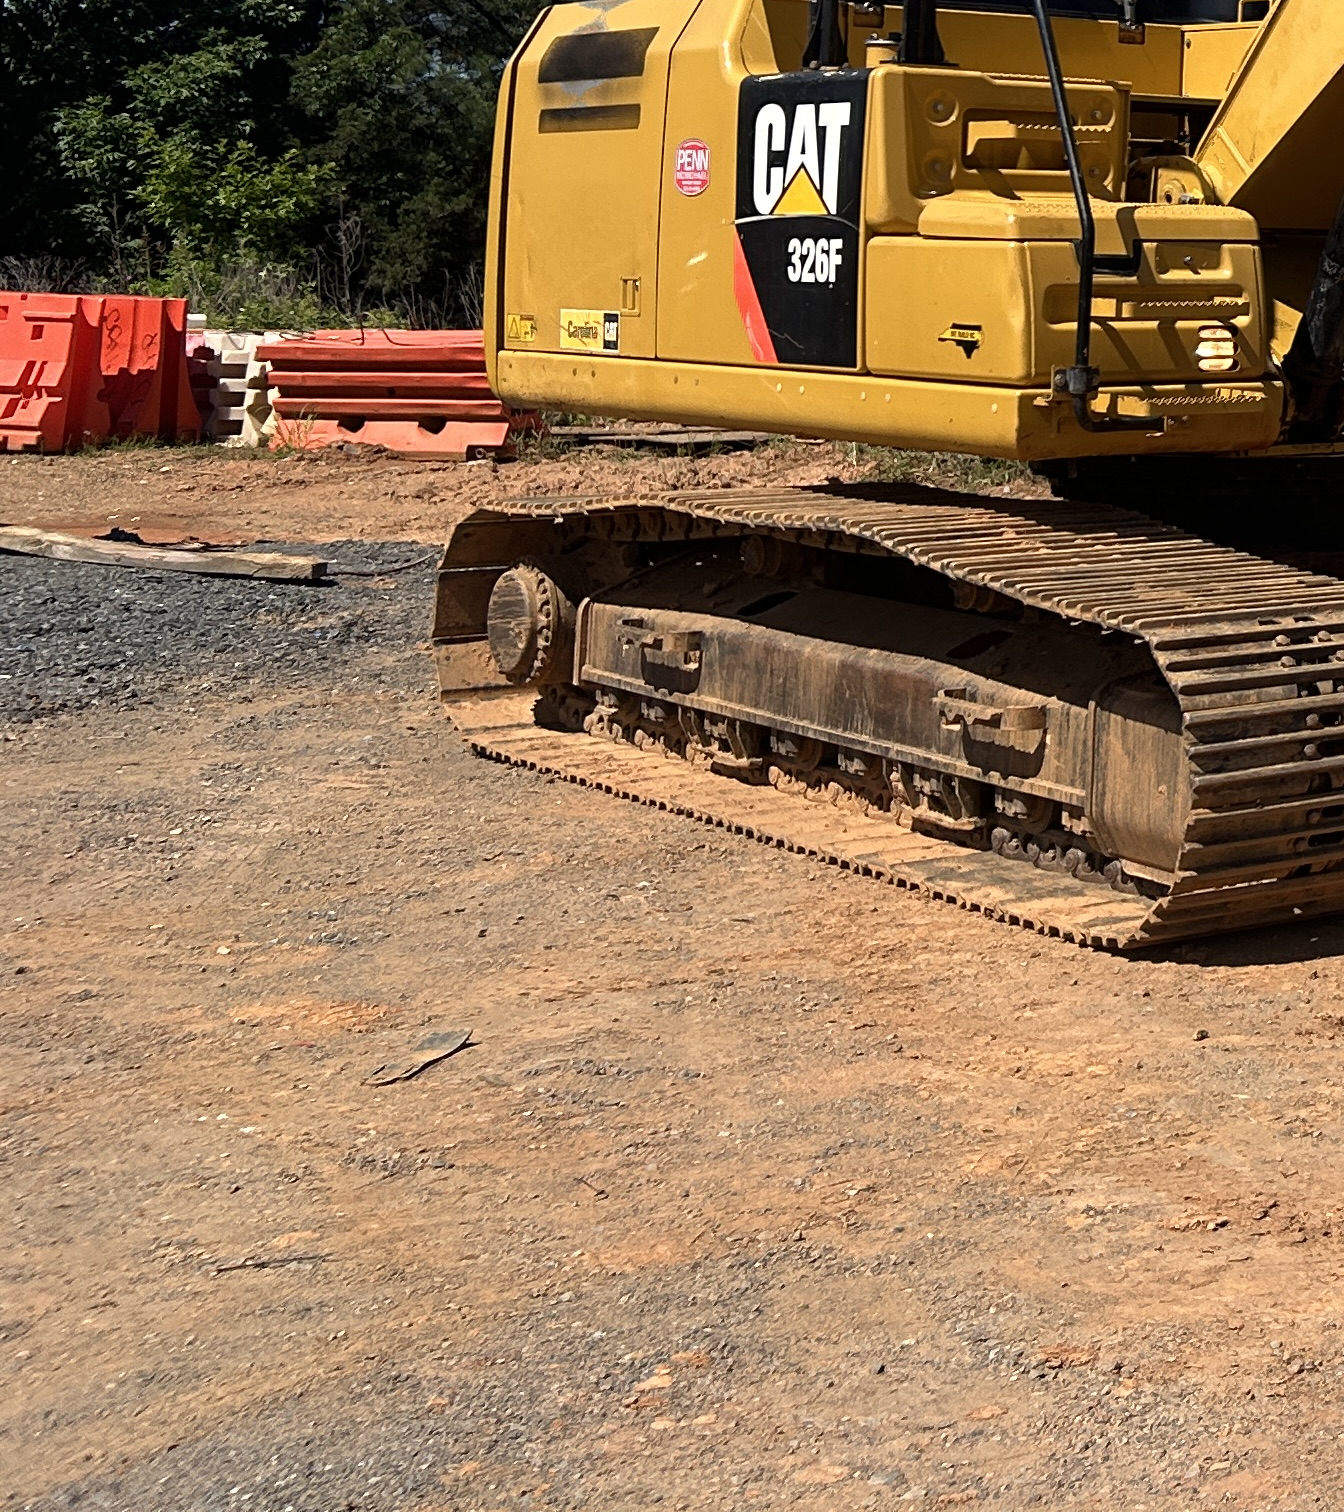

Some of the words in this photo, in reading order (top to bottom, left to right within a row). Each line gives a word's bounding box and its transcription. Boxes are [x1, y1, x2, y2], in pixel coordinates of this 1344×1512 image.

[677, 149, 709, 171] PENN
[753, 101, 851, 216] CAT
[787, 238, 843, 283] 326F
